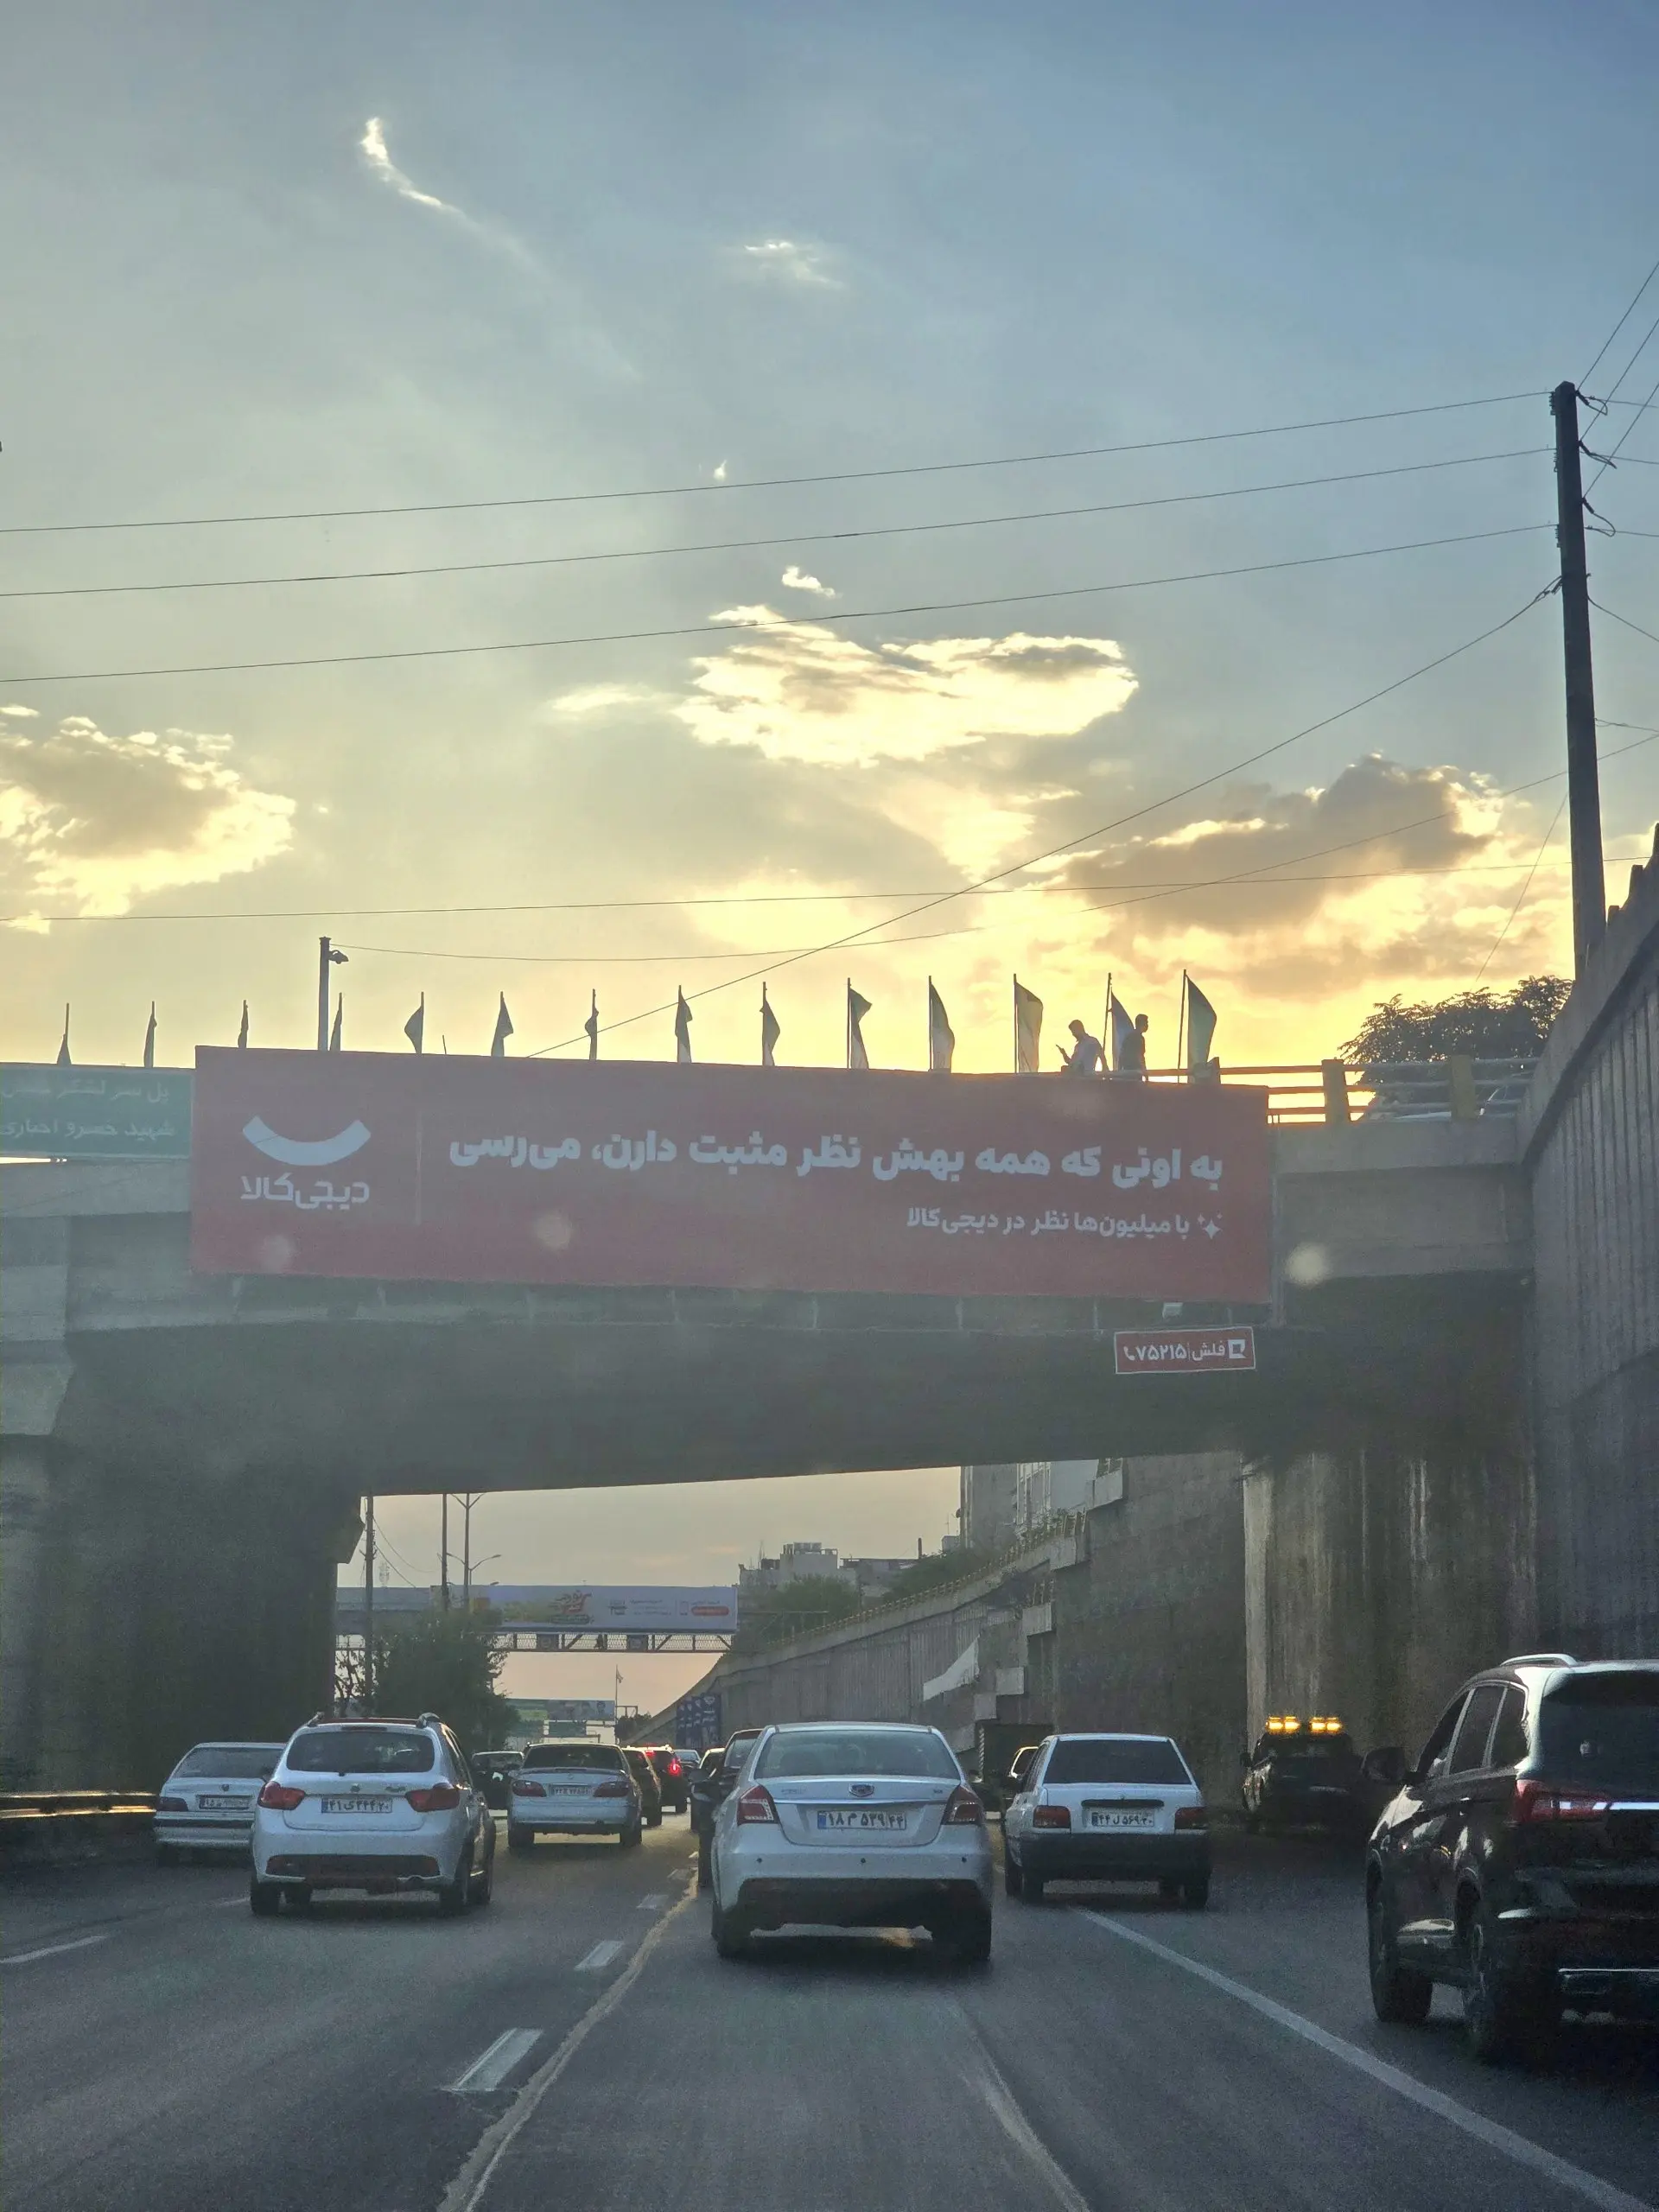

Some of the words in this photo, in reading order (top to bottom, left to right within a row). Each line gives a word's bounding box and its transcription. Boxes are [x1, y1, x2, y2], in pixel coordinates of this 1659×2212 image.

[591, 1129, 677, 1171] دارن،
[689, 1130, 787, 1175] مثبت
[796, 1134, 861, 1177] نظر
[873, 1137, 964, 1183] بهش
[975, 1147, 1051, 1176] همه
[1061, 1146, 1102, 1177] که
[1112, 1146, 1181, 1188] اونی
[1190, 1154, 1223, 1191] به
[1002, 1214, 1026, 1236] در
[1030, 1209, 1070, 1236] نظر
[1175, 1213, 1190, 1240] با
[1192, 1340, 1225, 1362] فلش
